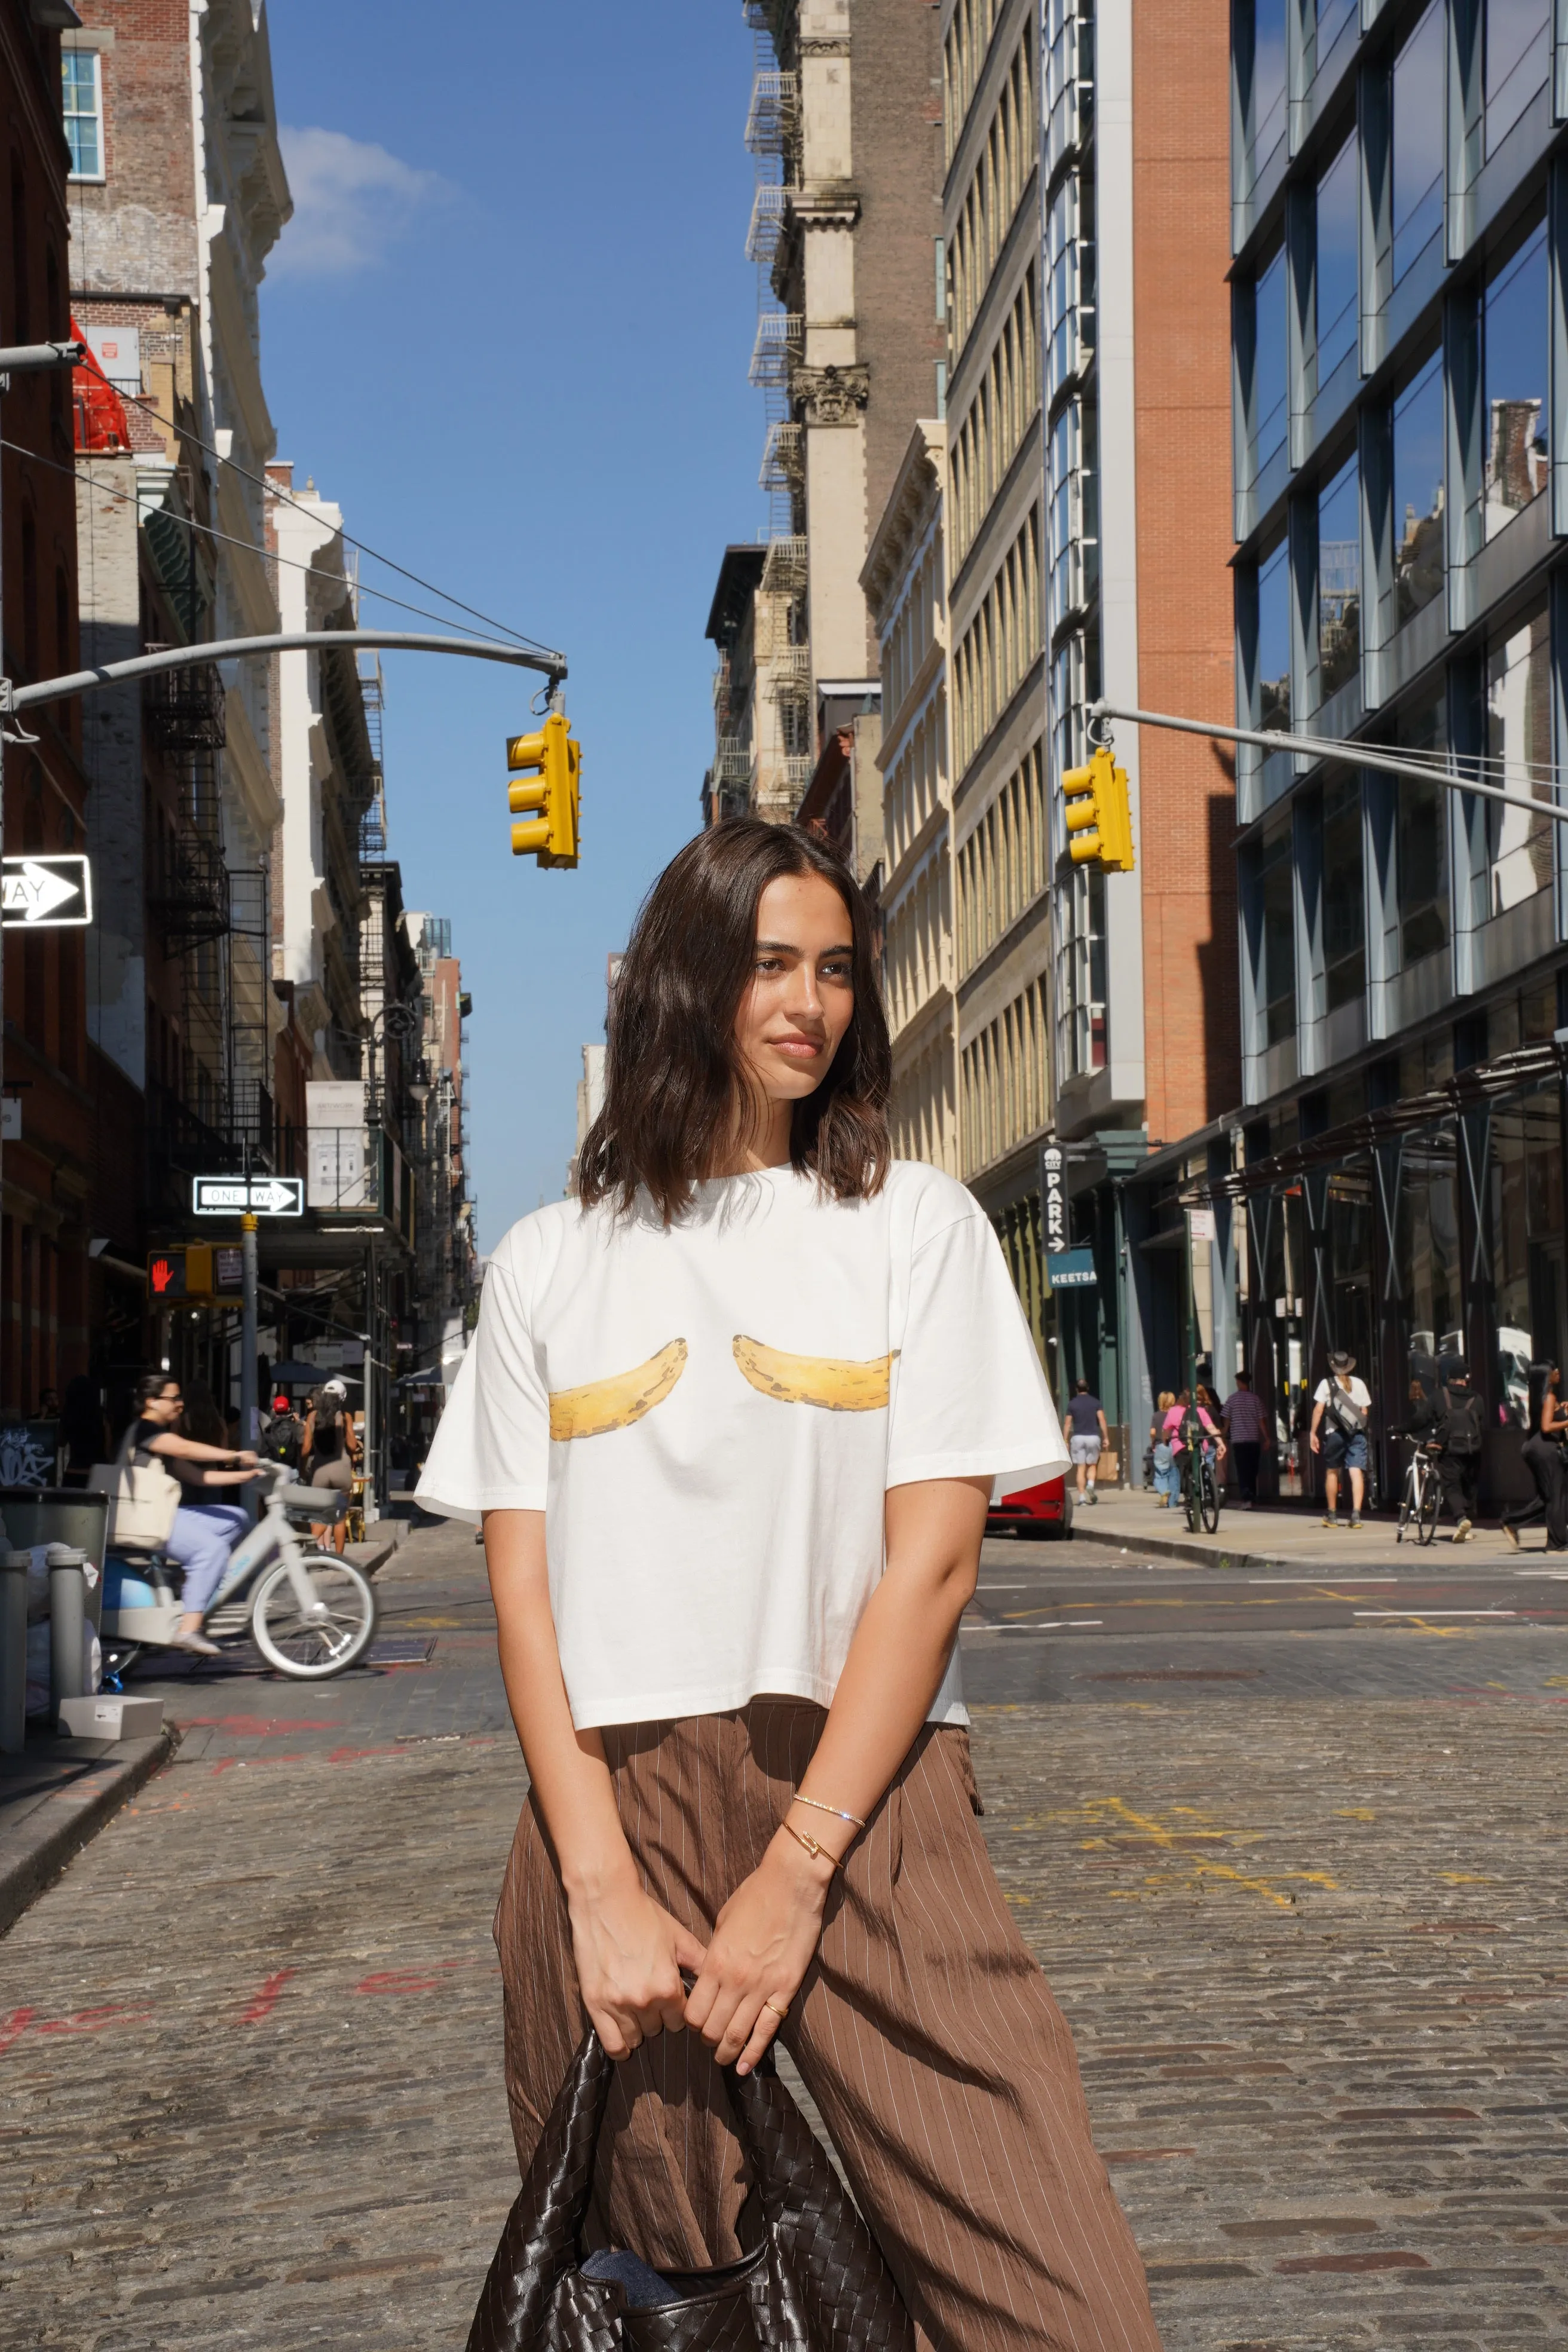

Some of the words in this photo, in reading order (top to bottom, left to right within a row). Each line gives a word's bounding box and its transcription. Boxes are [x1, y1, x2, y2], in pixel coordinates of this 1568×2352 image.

[2, 880, 45, 903] AY
[211, 1190, 241, 1202] ONE
[255, 1192, 283, 1202] WAY
[1047, 1172, 1063, 1235] PARK
[1052, 1271, 1097, 1284] KEETSA
